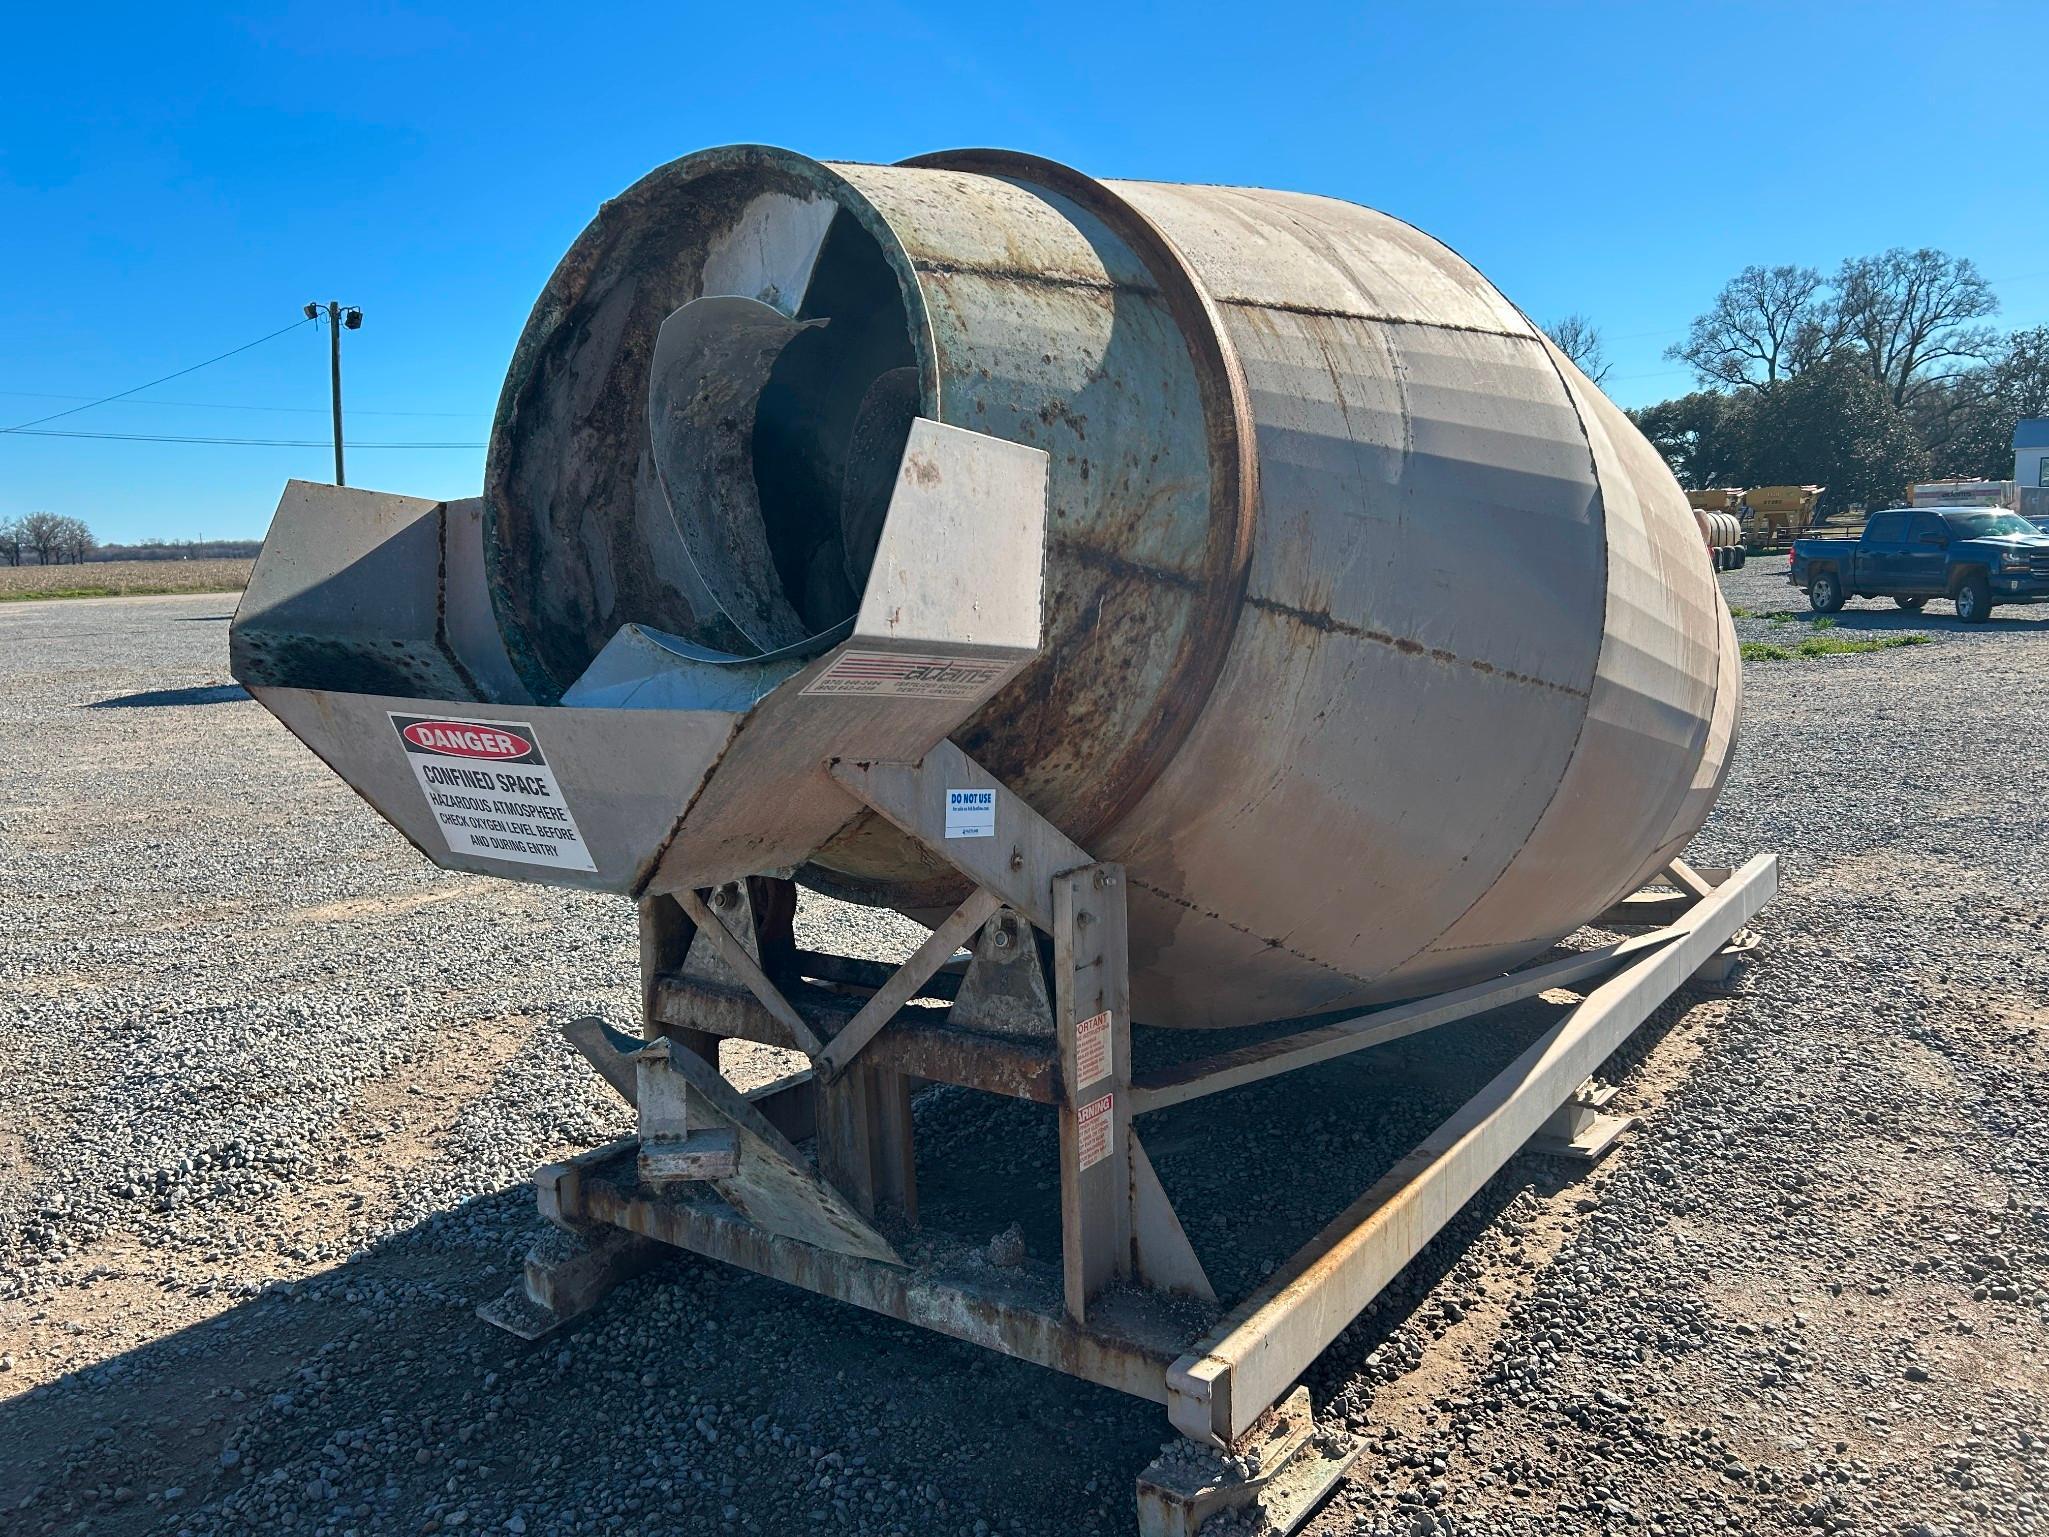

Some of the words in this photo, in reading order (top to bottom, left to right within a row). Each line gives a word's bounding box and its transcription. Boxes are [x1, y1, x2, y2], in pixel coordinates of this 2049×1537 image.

[903, 659, 994, 684] adams
[416, 727, 517, 754] DANGER
[422, 765, 495, 791] CONFINED
[496, 773, 550, 797] SPACE
[430, 792, 492, 812] HAZARDOUS
[494, 800, 568, 822] ATMOSPHERE
[951, 793, 962, 804] DO
[963, 793, 978, 804] NOT
[978, 793, 992, 804] USE
[439, 812, 469, 828] CHECK
[470, 816, 506, 833] OXYGEN
[506, 821, 537, 837] LEVEL
[537, 825, 577, 841] BEFORE
[470, 834, 489, 848] AND
[492, 837, 527, 853] DURING
[528, 842, 559, 857] ENTRY
[1077, 1012, 1108, 1034] ORTANT
[1077, 1098, 1110, 1123] ARNING
